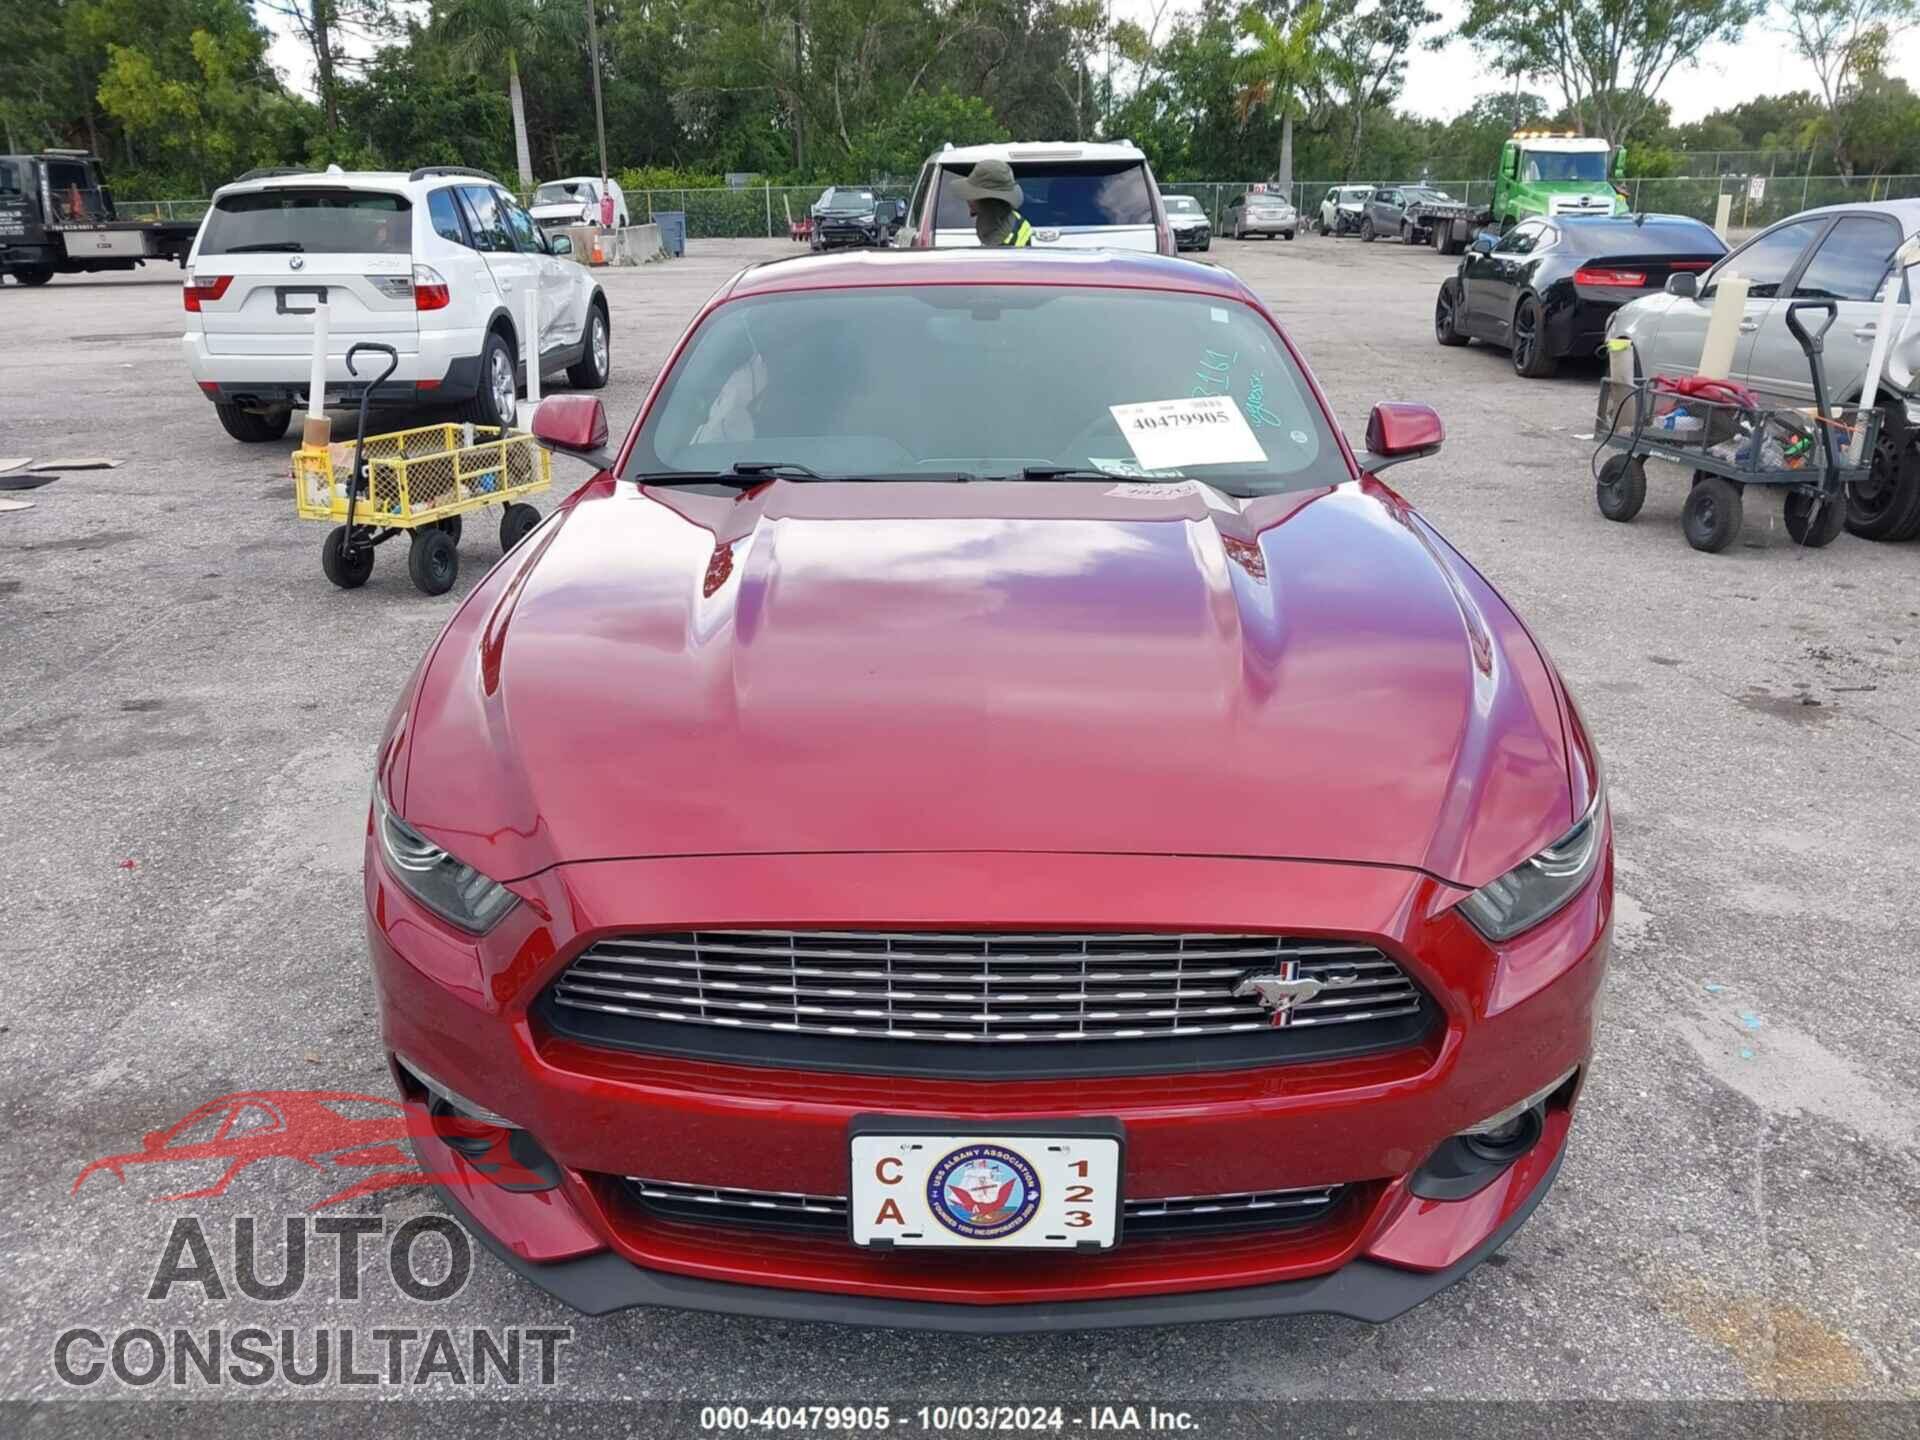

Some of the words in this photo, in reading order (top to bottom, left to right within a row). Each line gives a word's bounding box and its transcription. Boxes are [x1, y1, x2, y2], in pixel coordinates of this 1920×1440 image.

[1133, 410, 1230, 430] 40479905
[943, 1150, 980, 1170] ALBANY
[983, 1149, 1035, 1188] ASSOCIATION
